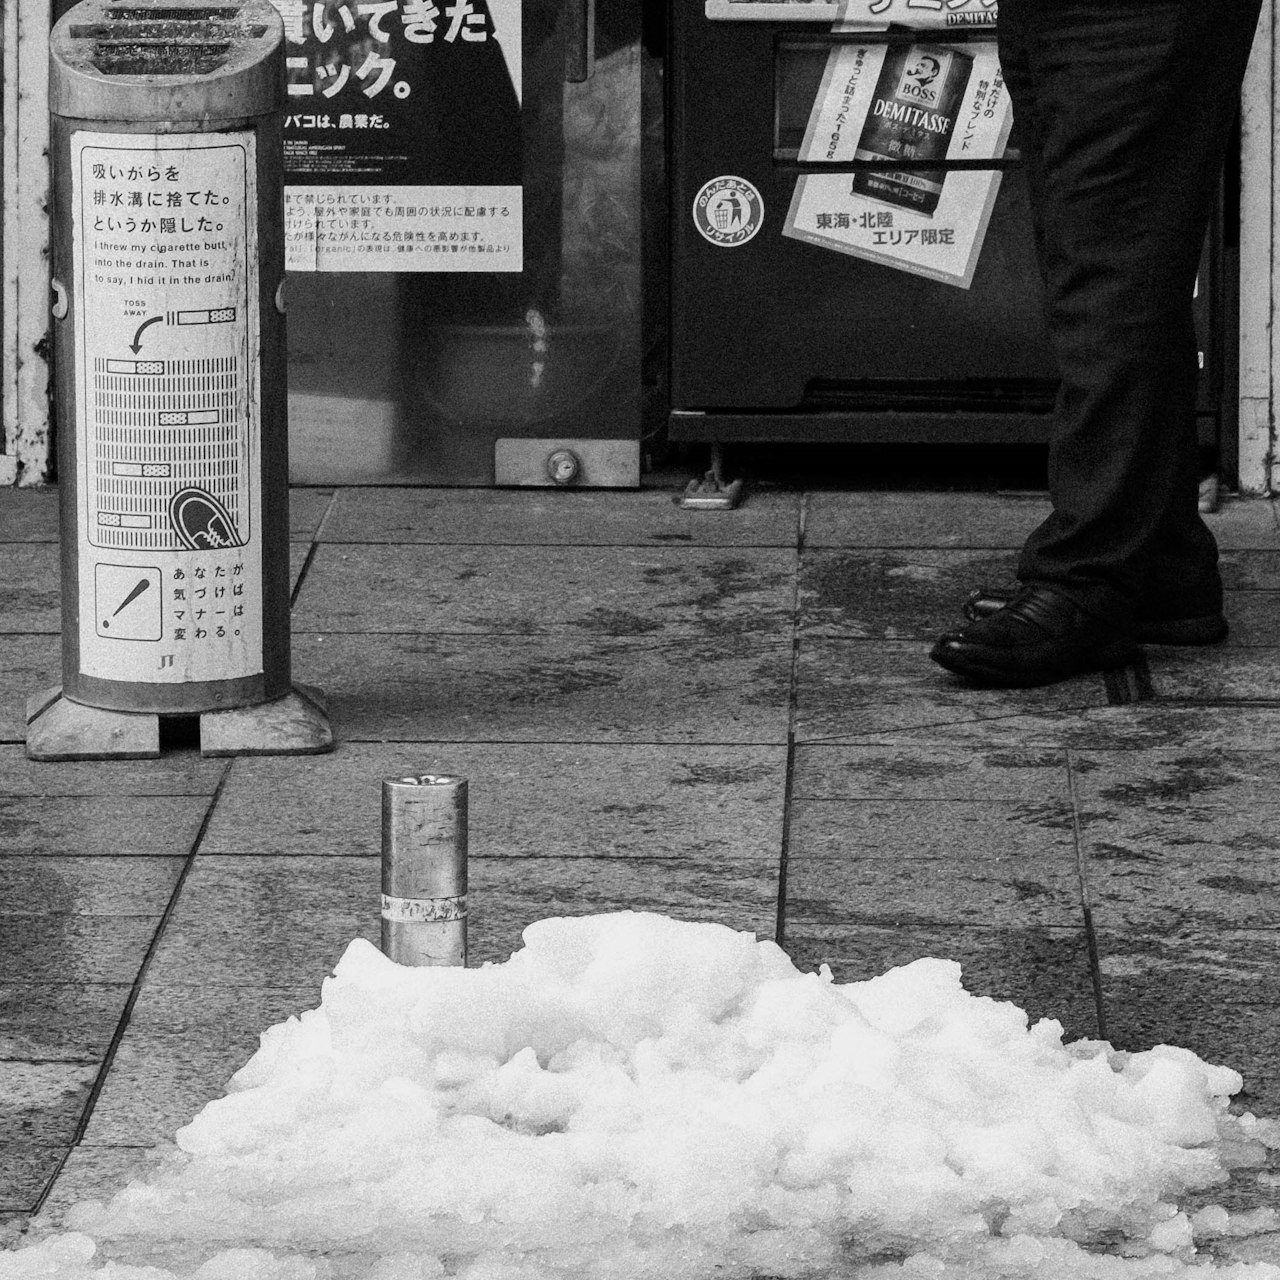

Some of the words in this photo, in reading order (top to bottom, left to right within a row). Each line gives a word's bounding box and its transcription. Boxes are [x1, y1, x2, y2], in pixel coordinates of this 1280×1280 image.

[901, 82, 937, 102] BOSS
[872, 97, 952, 136] DEMITASSE
[92, 163, 180, 182] 吸いがらを
[93, 189, 230, 208] 排水溝に捨てた。
[93, 215, 224, 234] というか隠した。
[814, 211, 894, 230] 東海・北陸
[872, 228, 956, 246] エリア限定
[100, 241, 128, 251] threw
[131, 244, 147, 254] my
[150, 242, 201, 254] cigarette
[94, 258, 113, 267] into
[116, 259, 132, 268] the
[135, 259, 168, 269] drain.
[172, 259, 196, 268] That
[199, 259, 209, 267] is
[95, 274, 104, 283] to
[106, 276, 127, 286] say,
[137, 276, 154, 285] hid
[158, 276, 166, 285] it
[169, 276, 180, 285] in
[183, 275, 201, 284] the
[204, 272, 234, 283] drain.
[124, 299, 146, 307] TOSS
[123, 309, 147, 317] AWAY
[172, 563, 245, 580] あなたが
[173, 582, 245, 602] 気づけば
[173, 604, 244, 621] マナーは
[173, 625, 242, 641] 変わる。
